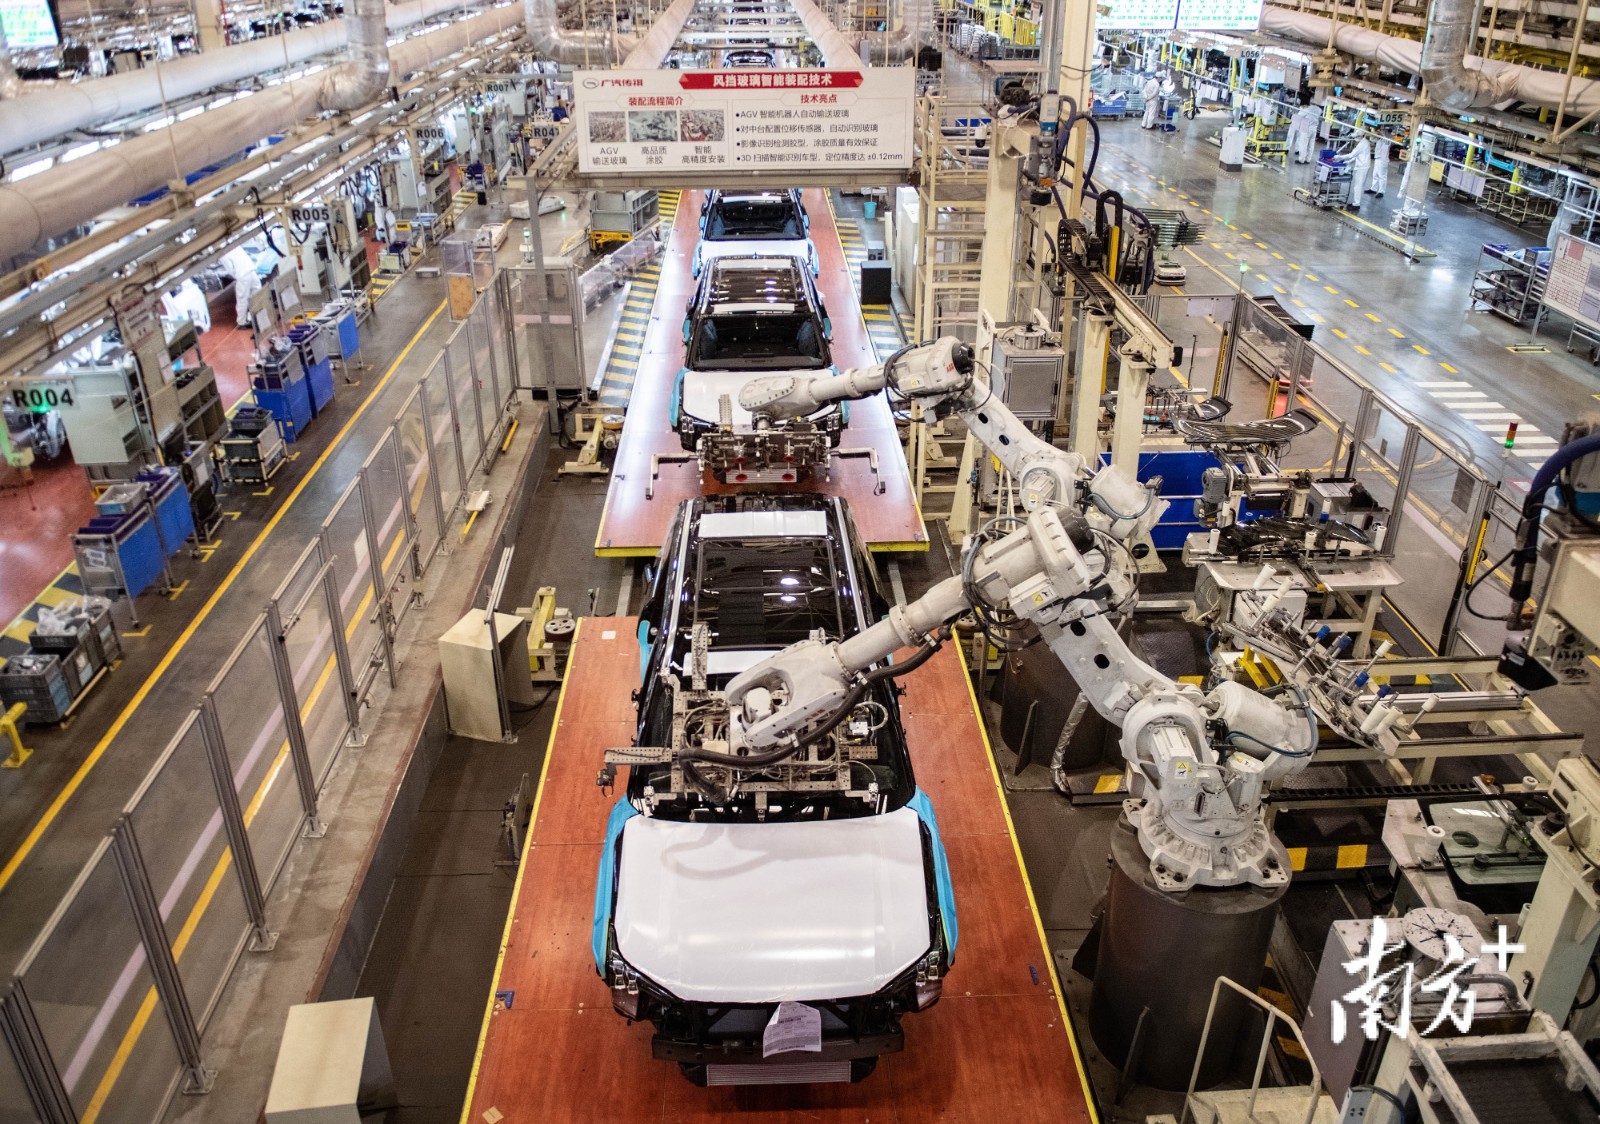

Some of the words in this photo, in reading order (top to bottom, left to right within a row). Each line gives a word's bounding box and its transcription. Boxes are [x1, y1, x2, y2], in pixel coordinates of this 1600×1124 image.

[713, 73, 833, 88] 风挡玻璃智能装配技术
[628, 96, 684, 106] 装配流程简介
[800, 93, 838, 104] 技术亮点
[740, 111, 758, 119] AGV
[760, 109, 850, 119] 智能机器人自动输送玻璃
[1379, 114, 1403, 123] L055
[416, 129, 444, 139] R006
[600, 147, 619, 155] AGV
[641, 146, 668, 155] 高品质
[694, 145, 712, 154] 智能
[592, 156, 628, 166] 输送玻璃
[646, 156, 664, 165] 涂胶
[682, 155, 726, 164] 高精度安装
[741, 154, 751, 162] 3D
[867, 153, 903, 161] ±0.12mm
[291, 208, 330, 221] R005
[12, 388, 74, 407] R004
